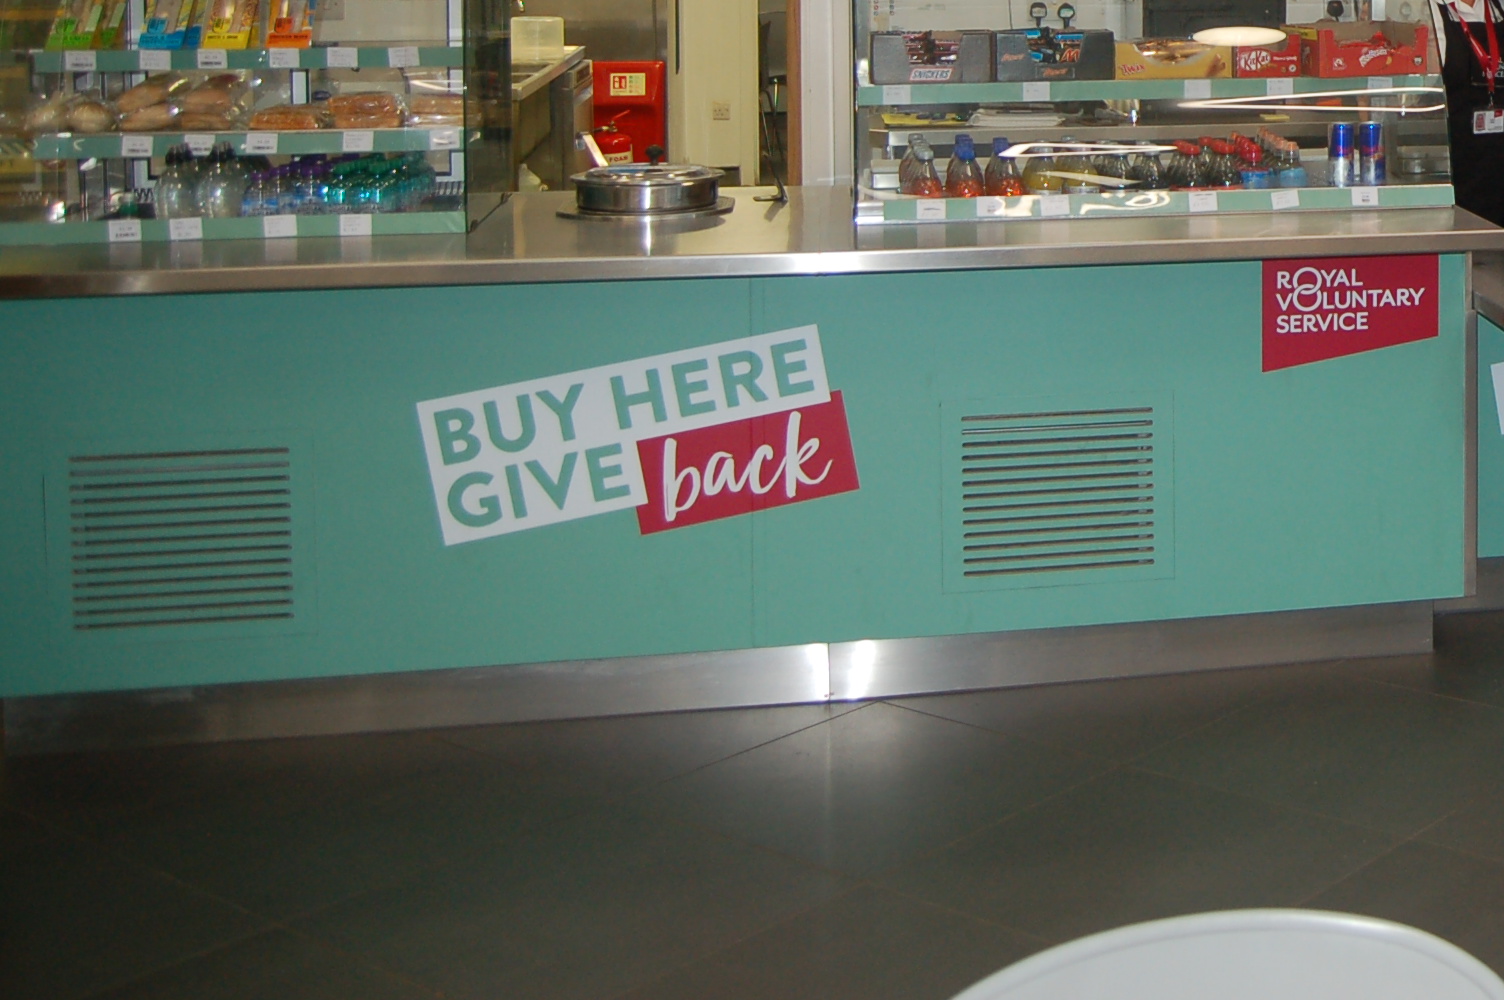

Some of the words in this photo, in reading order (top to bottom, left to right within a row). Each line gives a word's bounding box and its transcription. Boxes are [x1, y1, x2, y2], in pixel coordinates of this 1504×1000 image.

[1121, 63, 1145, 74] Twix
[1241, 51, 1270, 70] KitKat
[912, 69, 950, 79] SNICKERS
[1277, 266, 1363, 296] ROYAL
[1276, 285, 1425, 312] VOLUNTARY
[1276, 312, 1369, 334] SERVICE
[434, 383, 584, 465] BUY
[610, 339, 814, 429] HERE
[447, 443, 631, 528] GIVE
[664, 411, 833, 521] back
